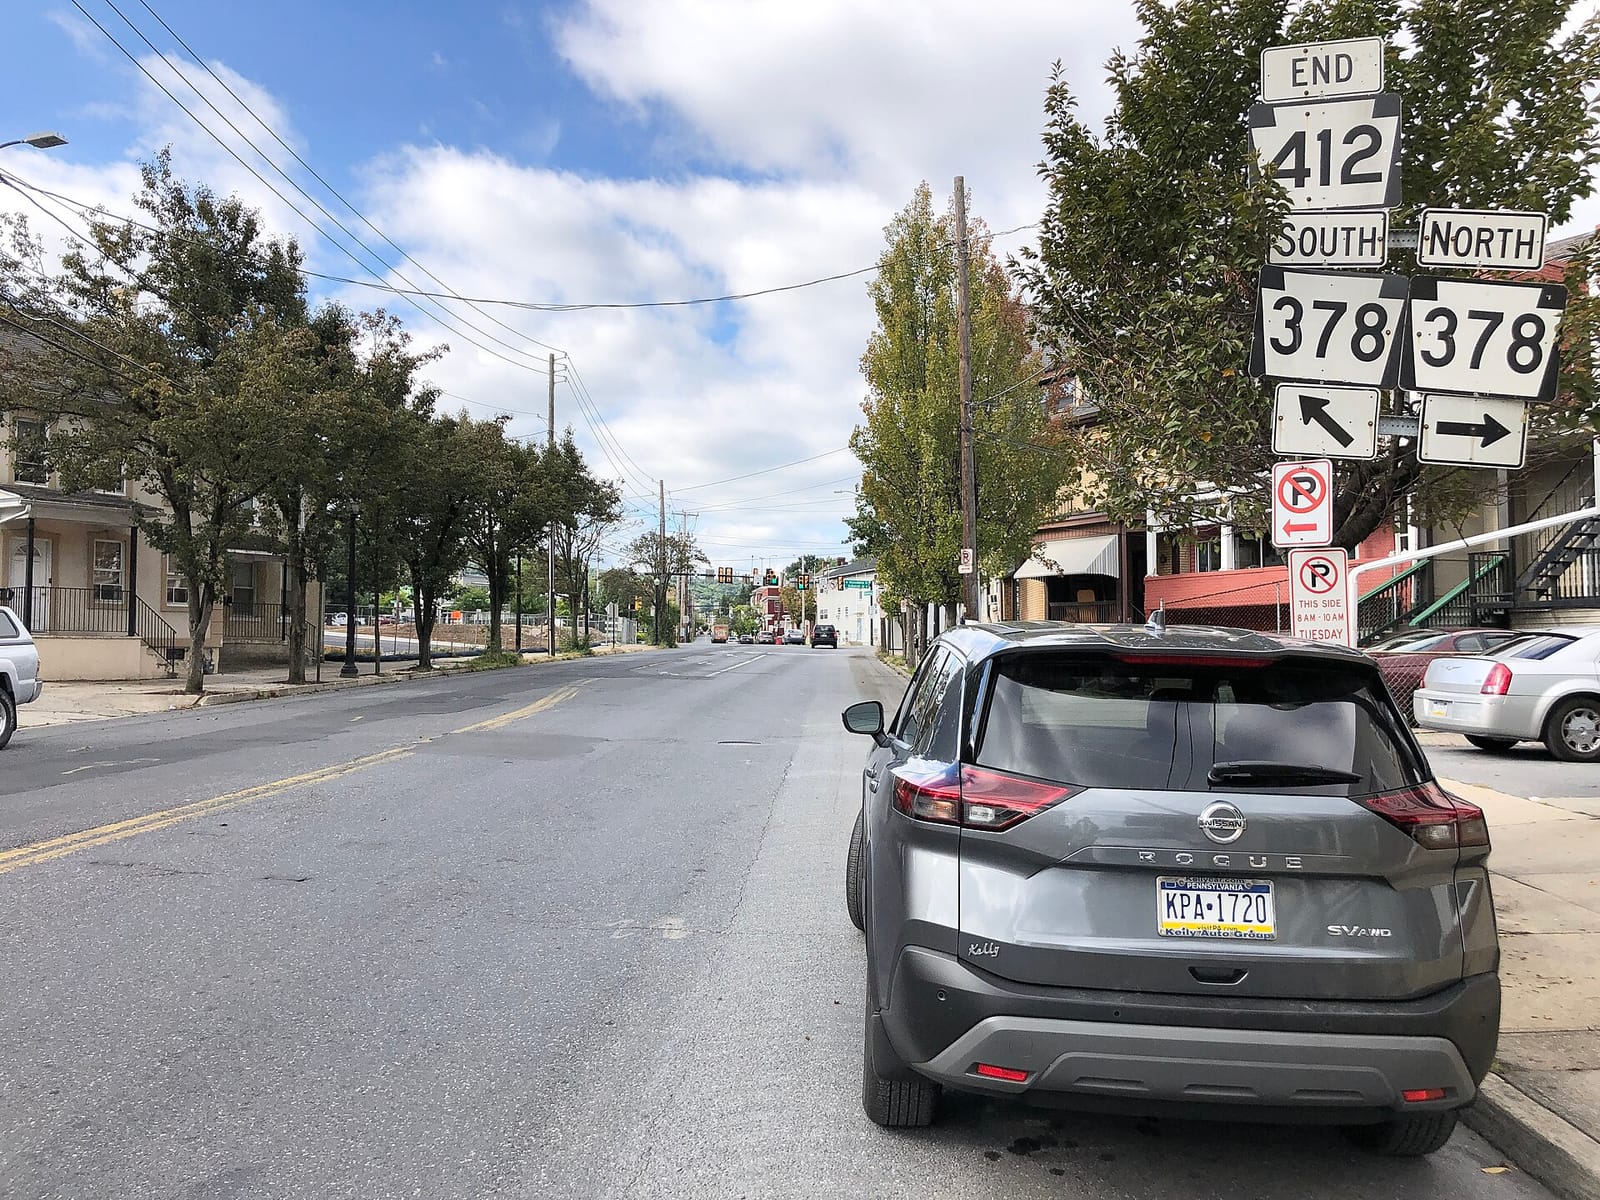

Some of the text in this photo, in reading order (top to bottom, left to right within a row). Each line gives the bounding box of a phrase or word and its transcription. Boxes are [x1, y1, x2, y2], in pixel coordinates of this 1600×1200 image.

[1291, 53, 1354, 88] END
[1271, 124, 1383, 189] 412
[1275, 222, 1378, 257] SOUTH
[1429, 220, 1536, 260] NORTH
[1269, 295, 1389, 363] 378
[1420, 306, 1547, 374] 378
[1299, 599, 1341, 608] THIS SIDE
[1299, 629, 1343, 640] TUESDAY
[1204, 818, 1242, 828] NISSAN
[1138, 851, 1303, 869] ROGUE
[1187, 882, 1244, 891] PENNSYLVANIA
[1200, 929, 1229, 938] Auto
[1233, 930, 1273, 940] Group
[1327, 925, 1359, 936] SV
[967, 942, 1000, 957] Kelly
